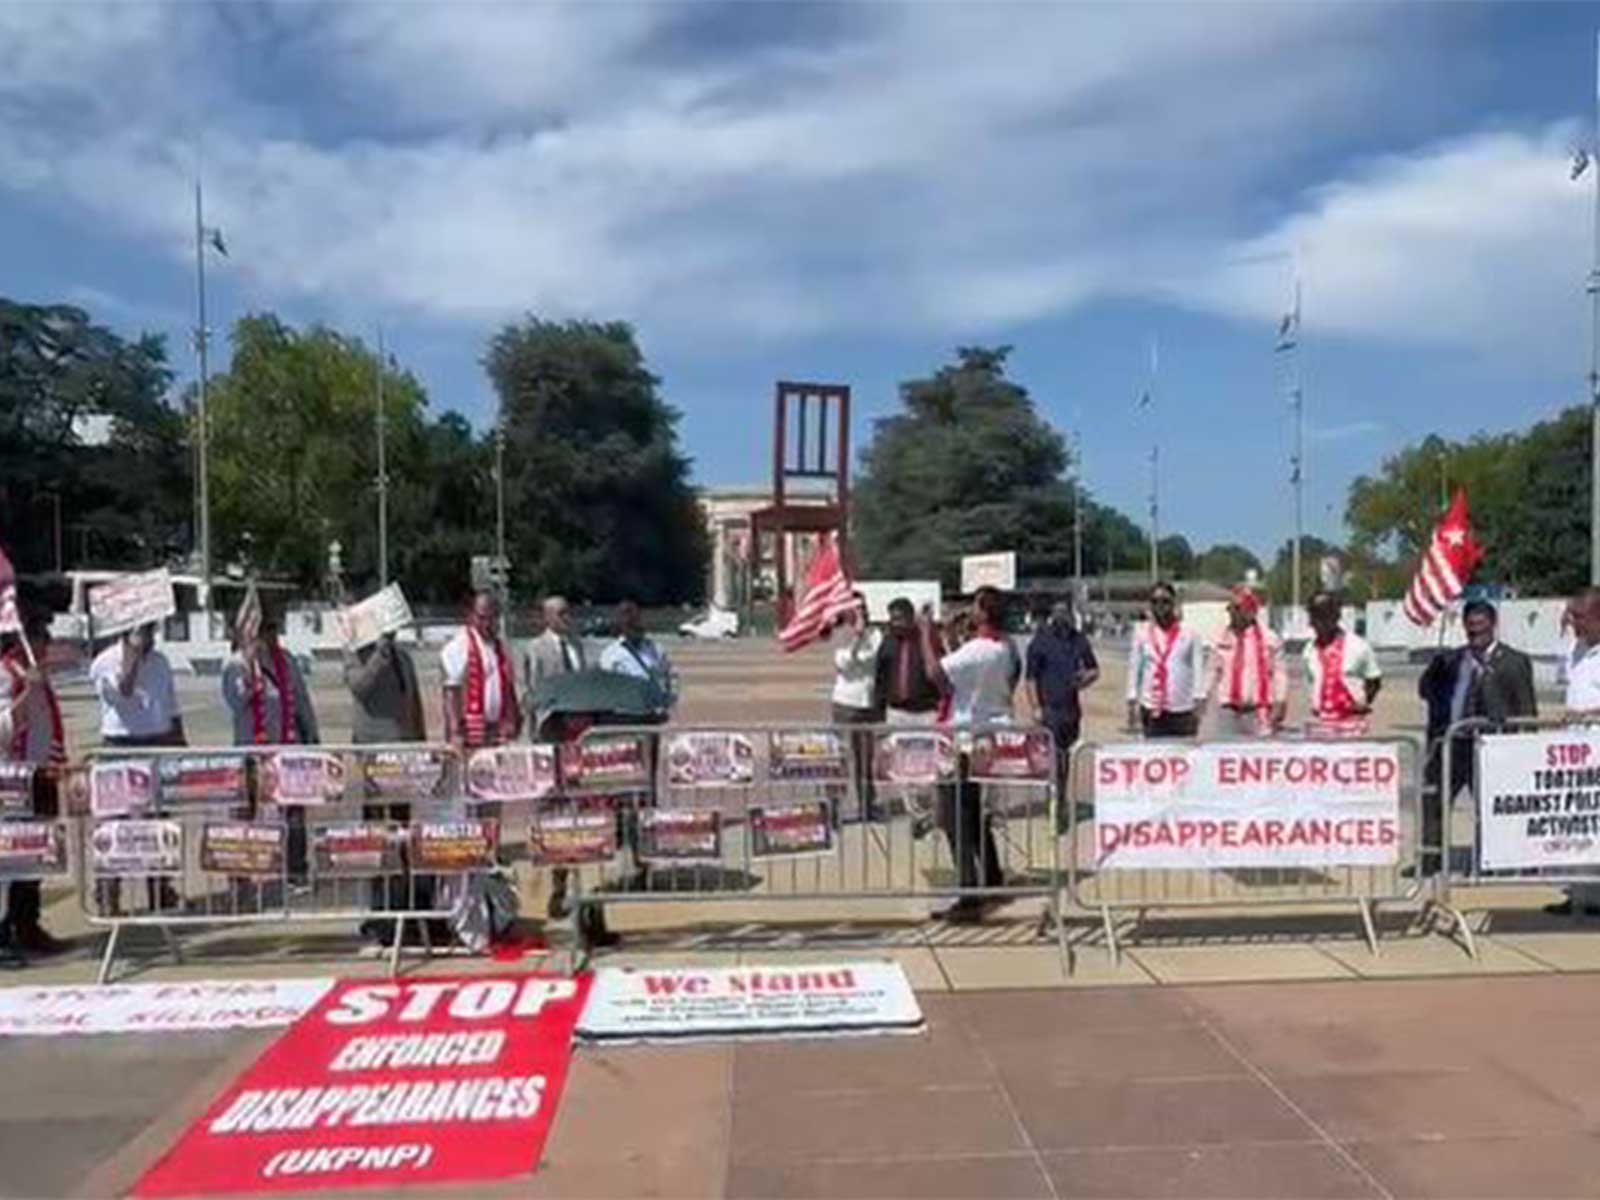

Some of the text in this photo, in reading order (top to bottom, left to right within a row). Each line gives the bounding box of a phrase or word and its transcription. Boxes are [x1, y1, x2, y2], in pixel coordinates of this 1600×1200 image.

[1100, 756, 1396, 785] STOP ENFORCED
[1546, 743, 1590, 766] STOP
[1494, 795, 1561, 815] AGAINST
[1100, 819, 1396, 851] DISAPPEARANCES
[643, 973, 710, 996] We
[730, 968, 854, 993] stand
[325, 979, 577, 1023] STOP
[330, 1030, 506, 1071] ENFORCED
[208, 1074, 547, 1135] DISAPPEARANCES
[263, 1143, 432, 1177] (UKPNP)
